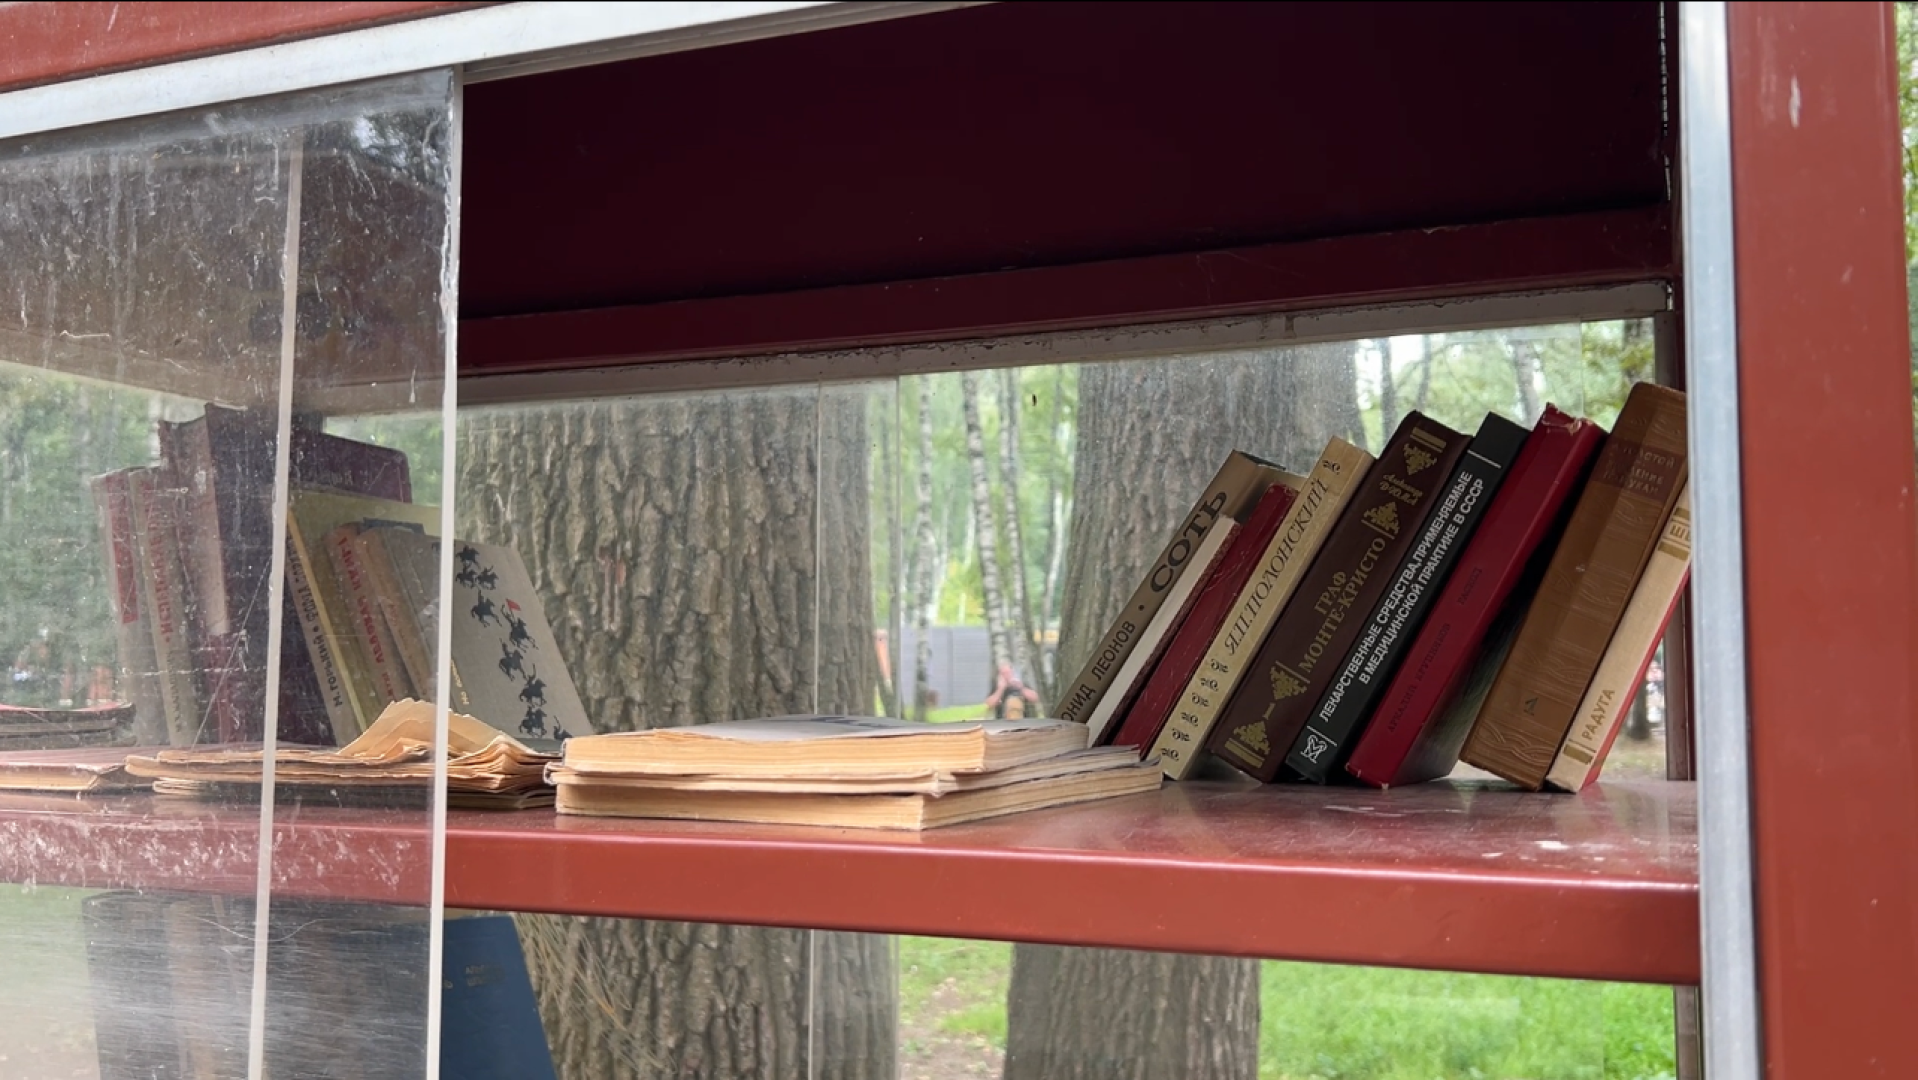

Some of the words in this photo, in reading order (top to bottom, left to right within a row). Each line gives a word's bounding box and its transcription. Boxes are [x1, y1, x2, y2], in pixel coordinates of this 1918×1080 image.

[1061, 683, 1097, 722] ОНИД
[1091, 620, 1136, 682] ЛЕОНОВ
[1151, 491, 1227, 593] СОТЬ
[1298, 537, 1386, 673] МОНТЕ-КРИСТО
[1313, 571, 1347, 615] ГРАФ
[1358, 672, 1371, 685] В
[1366, 582, 1425, 681] МЕДИЦИНСКОЙ
[1419, 522, 1460, 592] ПРАКТИКЕ
[1453, 512, 1465, 525] В
[1461, 478, 1484, 515] СССР
[1318, 622, 1383, 723] ЛЕКАРСТВЕННЫЕ
[1581, 689, 1615, 741] РАДУГА
